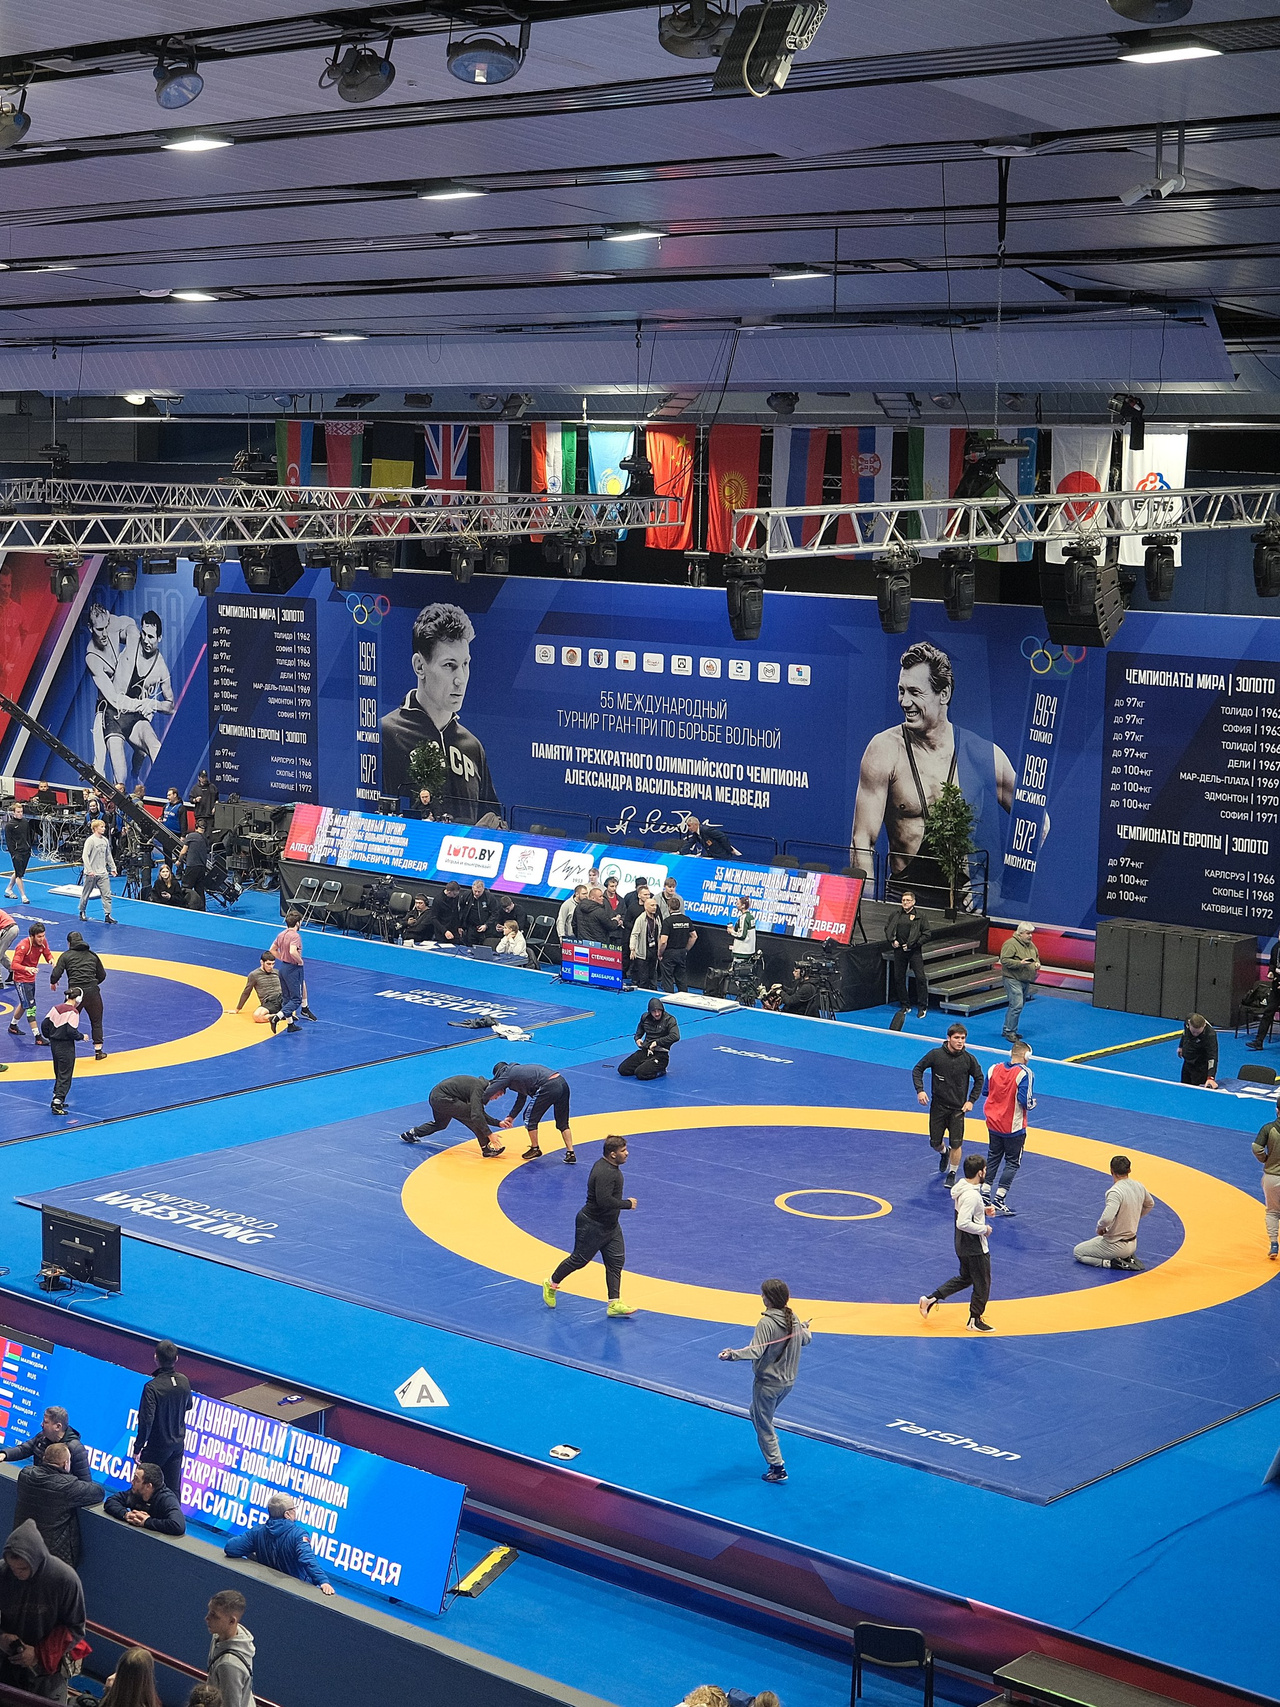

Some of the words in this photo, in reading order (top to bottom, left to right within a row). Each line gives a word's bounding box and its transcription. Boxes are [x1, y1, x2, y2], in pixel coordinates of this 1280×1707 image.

[218, 604, 258, 620] ЧЕМПИОНАТЫ
[259, 609, 276, 621] МИРА
[281, 610, 305, 623] ЗОЛОТО
[297, 632, 311, 641] 1962
[276, 645, 293, 653] СОФИЯ
[297, 645, 311, 654] 1963
[359, 641, 376, 672] 1964
[297, 659, 311, 668] 1966
[280, 672, 294, 680] ДЕЛИ
[297, 672, 311, 681] 1967
[358, 674, 377, 687] ТОКИО
[1125, 668, 1194, 689] ЧЕМПИОНАТЫ
[1196, 673, 1226, 691] МИРА
[1235, 676, 1276, 694] ЗОЛОТО
[297, 685, 311, 694] 1969
[298, 698, 311, 707] 1970
[600, 690, 614, 709] 55
[617, 692, 728, 720] МЕЖДУНАРОДНЫЙ
[1032, 692, 1058, 729] 1964
[1114, 699, 1124, 708] до
[1126, 697, 1146, 708] 97кг
[277, 711, 295, 719] СОФИЯ
[298, 711, 311, 720] 1971
[359, 697, 377, 729] 1968
[1113, 715, 1124, 724] до
[1125, 714, 1145, 725] 97кг
[1220, 706, 1253, 717] ТОЛИДО
[218, 723, 257, 739] ЧЕМПИОНАТЫ
[257, 728, 281, 742] ЕВРОПЫ
[285, 731, 307, 745] ЗОЛОТО
[557, 709, 599, 728] ТУРНИР
[602, 713, 658, 737] ГРАН-ПРИ
[660, 719, 676, 738] ПО
[678, 721, 722, 744] БОРЬБЕ
[725, 725, 781, 750] ВОЛЬНОЙ
[1029, 728, 1053, 745] ТОКИО
[1112, 732, 1123, 741] до
[1124, 730, 1144, 742] 97кг
[1222, 724, 1252, 734] СОФИЯ
[356, 731, 380, 744] МЕХИКО
[1111, 749, 1122, 758] до
[1123, 748, 1149, 760] 97+кг
[1221, 741, 1254, 753] ТОЛИДО
[298, 757, 312, 767] 1966
[360, 753, 377, 785] 1972
[531, 742, 573, 762] ПАМЯТИ
[575, 747, 653, 771] ТРЕХКРАТНОГО
[655, 754, 744, 781] ОЛИМПИЙСКОГО
[746, 765, 809, 789] ЧЕМПИОНА
[1227, 759, 1251, 769] ДЕЛИ
[276, 769, 295, 778] СКОПЬЕ
[298, 770, 312, 780] 1968
[1022, 753, 1048, 790] 1968
[1111, 766, 1121, 775] до
[1123, 765, 1153, 777] 100+кг
[298, 784, 312, 793] 1972
[564, 768, 633, 792] АЛЕКСАНДРА
[635, 774, 712, 801] ВАСИЛЬЕВИЧА
[715, 785, 770, 808] МЕДВЕДЯ
[1110, 783, 1120, 792] до
[1122, 782, 1152, 794] 100+кг
[1179, 772, 1250, 787] МАР-ДЕЛЬ-ПЛАТА
[1257, 777, 1279, 789] 1969
[356, 787, 381, 801] МЮНХЕН
[1015, 788, 1046, 807] МЕХИКО
[1204, 792, 1248, 804] ЭДМОНТОН
[1256, 794, 1279, 807] 1970
[1109, 799, 1120, 808] до
[1122, 798, 1152, 811] 100+кг
[1220, 810, 1249, 821] СОФИЯ
[1256, 812, 1278, 824] 1971
[1012, 817, 1037, 854] 1972
[1117, 824, 1180, 845] ЧЕМПИОНАТЫ
[1183, 831, 1222, 850] ЕВРОПЫ
[1231, 837, 1269, 855] ЗОЛОТО
[290, 842, 336, 857] АЛЕКСАНДРА
[338, 850, 390, 865] ВАСИЛЬЕВИЧА
[391, 857, 428, 871] МЕДВЕДЯ
[1004, 852, 1037, 873] МЮНХЕН
[1108, 858, 1118, 867] до
[1119, 857, 1144, 869] 97+кг
[1107, 875, 1117, 883] до
[1119, 874, 1149, 887] 100+кг
[1204, 869, 1245, 882] КАРЛСРУЭ
[1252, 873, 1275, 885] 1966
[1106, 891, 1117, 900] до
[1118, 890, 1148, 903] 100+кг
[1212, 887, 1244, 898] СКОПЬЕ
[1251, 890, 1275, 902] 1968
[683, 901, 729, 917] ЕКСАНДРА
[800, 917, 846, 934] МЕДВЕДЯ
[1201, 903, 1243, 916] КАТОВИЦЕ
[1251, 907, 1273, 919] 1972
[374, 989, 518, 1019] WRESTLING
[93, 1190, 276, 1245] WRESTLING
[141, 1190, 211, 1212] UNITED
[207, 1207, 279, 1231] WORLD
[399, 1381, 412, 1399] A
[416, 1384, 435, 1404] A
[184, 1396, 288, 1459] ЖДУНАРОДНЫЙ
[288, 1430, 341, 1476] ТУРНИР
[885, 1418, 1021, 1461] TaiShan
[199, 1433, 240, 1469] БОРЬБЕ
[310, 1531, 402, 1587] МЕДВЕДЯ
